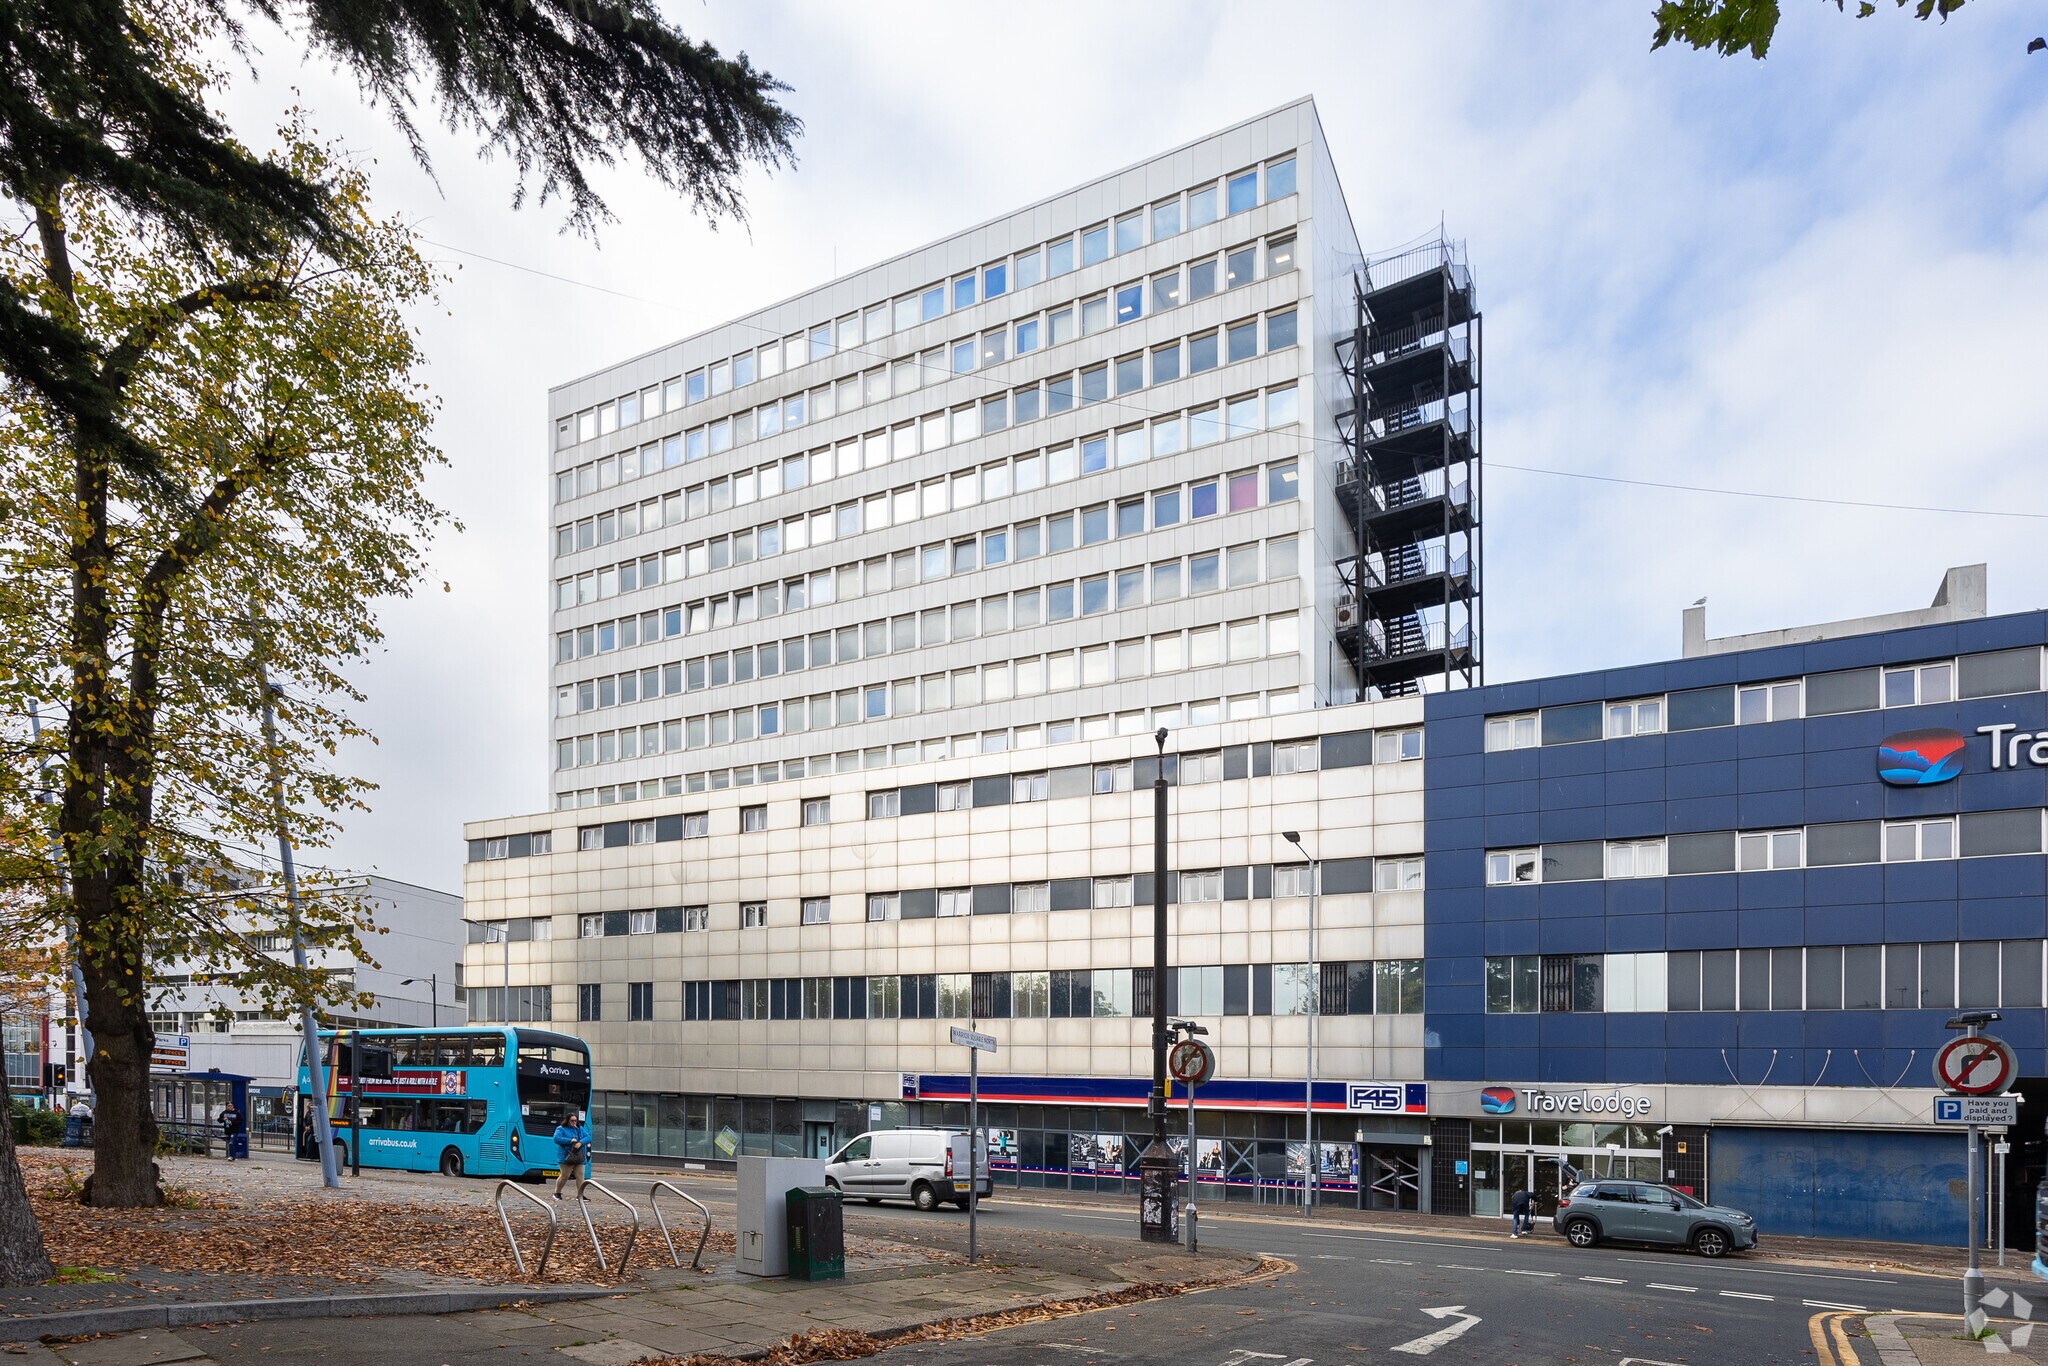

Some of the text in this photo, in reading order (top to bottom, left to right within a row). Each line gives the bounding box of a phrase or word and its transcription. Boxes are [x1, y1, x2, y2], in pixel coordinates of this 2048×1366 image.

[953, 1030, 970, 1038] WARRIOR
[970, 1033, 984, 1042] SQUARE
[548, 1066, 570, 1076] arriva
[1350, 1086, 1401, 1110] F45
[1521, 1089, 1652, 1118] Travelodge
[368, 1137, 417, 1148] arrivabus.co.uk
